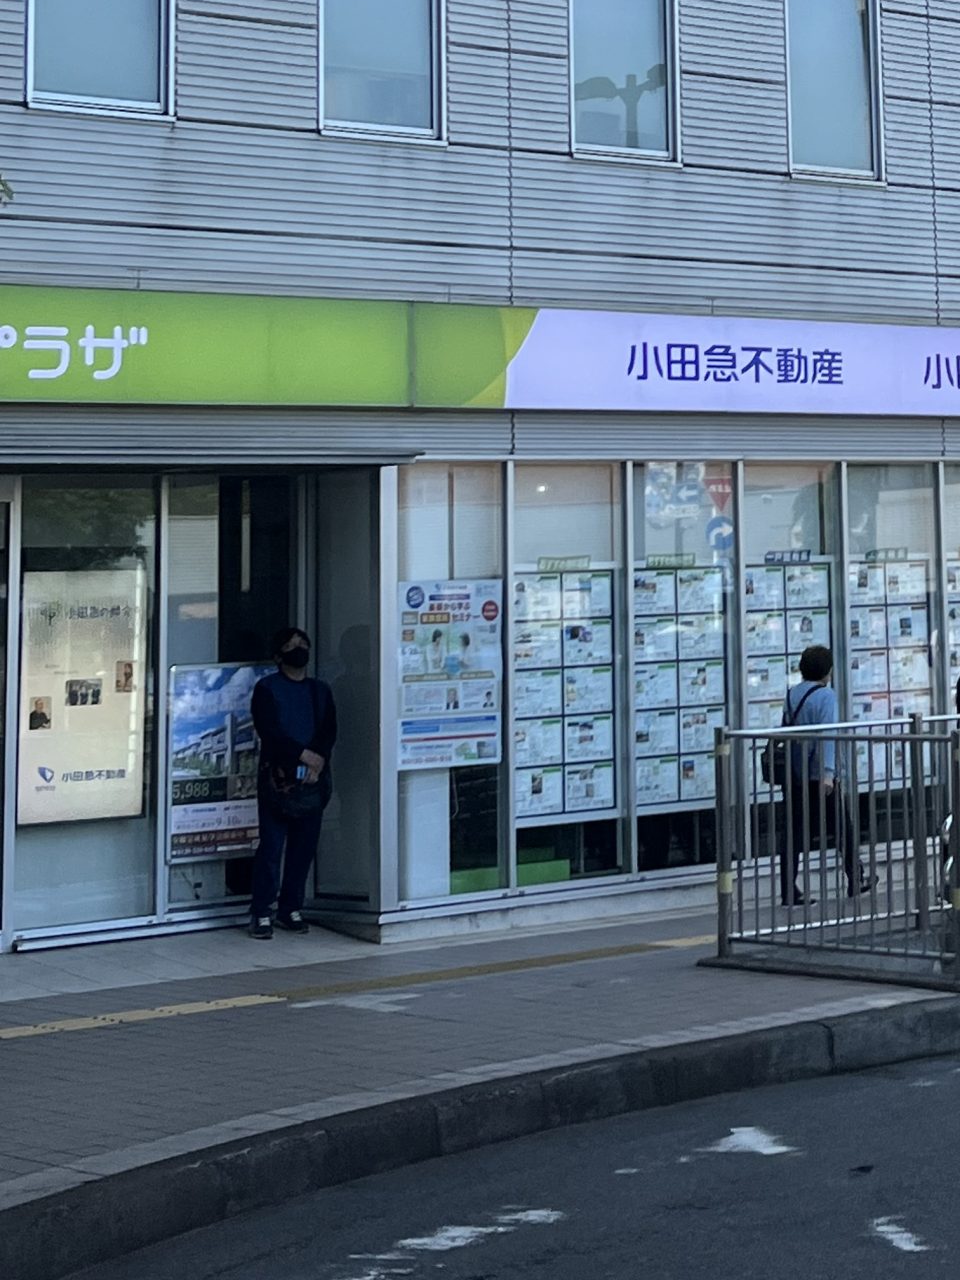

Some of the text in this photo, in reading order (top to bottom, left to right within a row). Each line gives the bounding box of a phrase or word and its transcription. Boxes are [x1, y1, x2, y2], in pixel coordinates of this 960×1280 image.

[627, 342, 844, 386] 小田急不動産
[172, 781, 210, 799] 5,988
